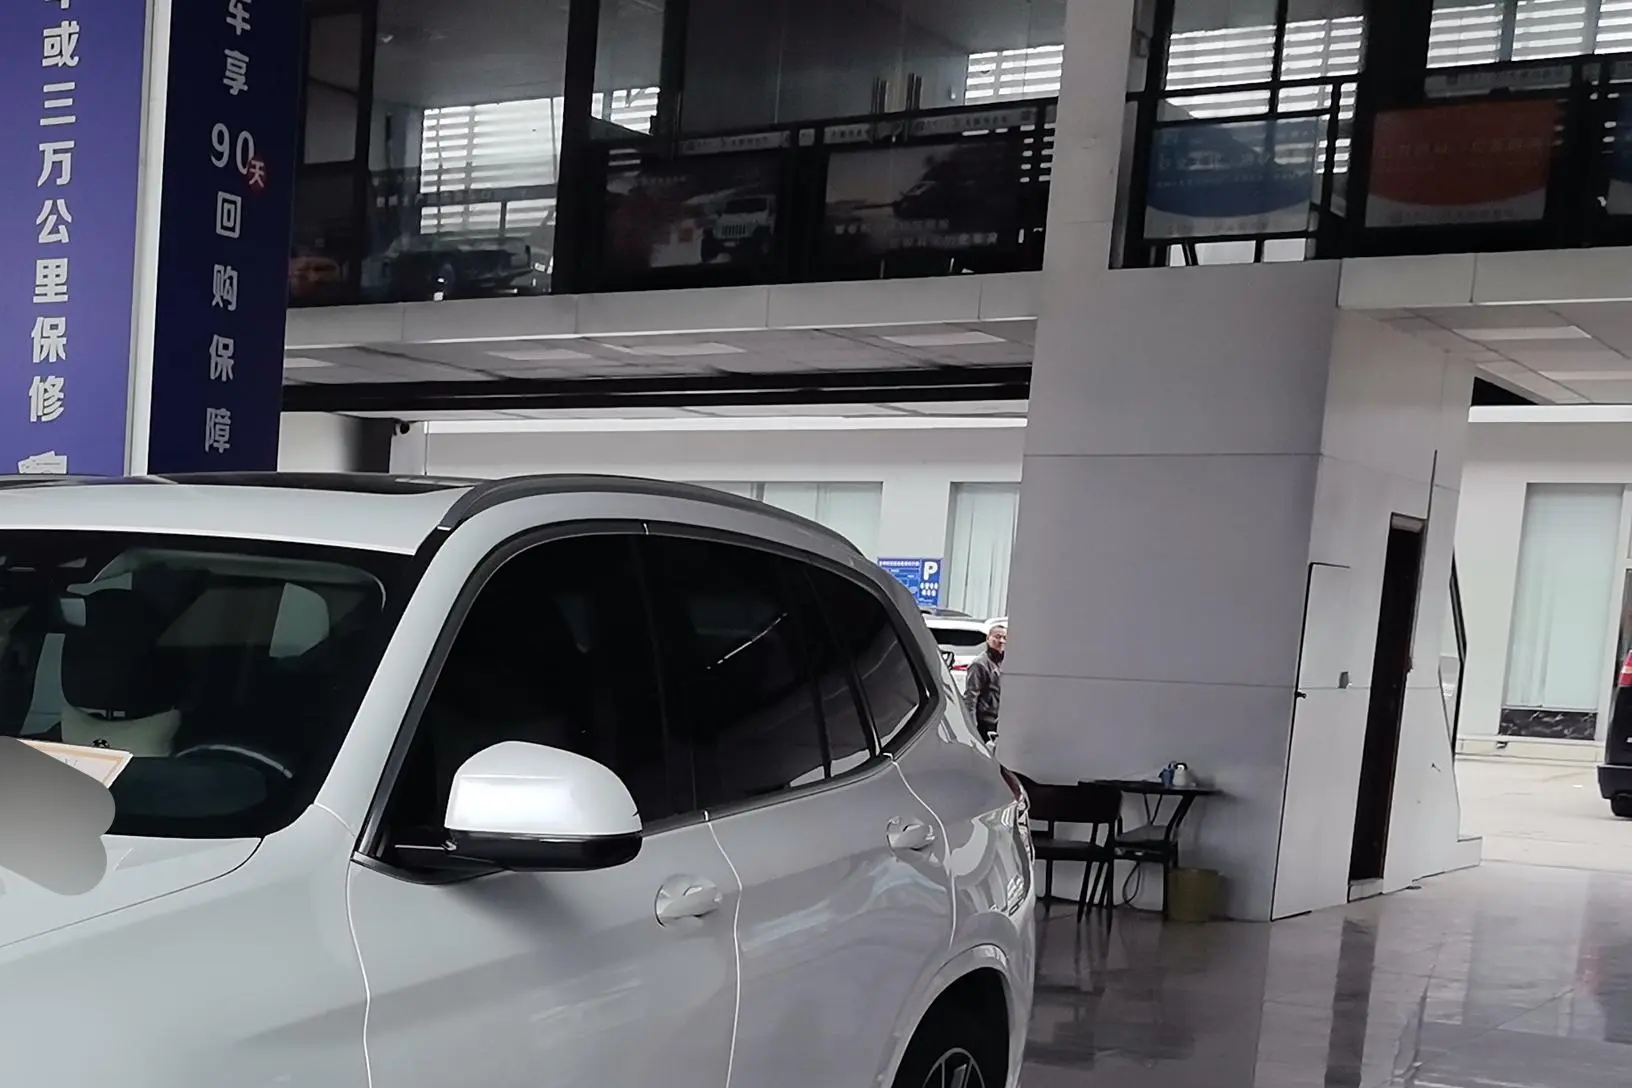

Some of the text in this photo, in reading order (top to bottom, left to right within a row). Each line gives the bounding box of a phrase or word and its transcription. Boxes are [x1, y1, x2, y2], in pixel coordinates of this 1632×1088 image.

[28, 0, 79, 423] 或三万公里保修
[924, 561, 938, 581] P
